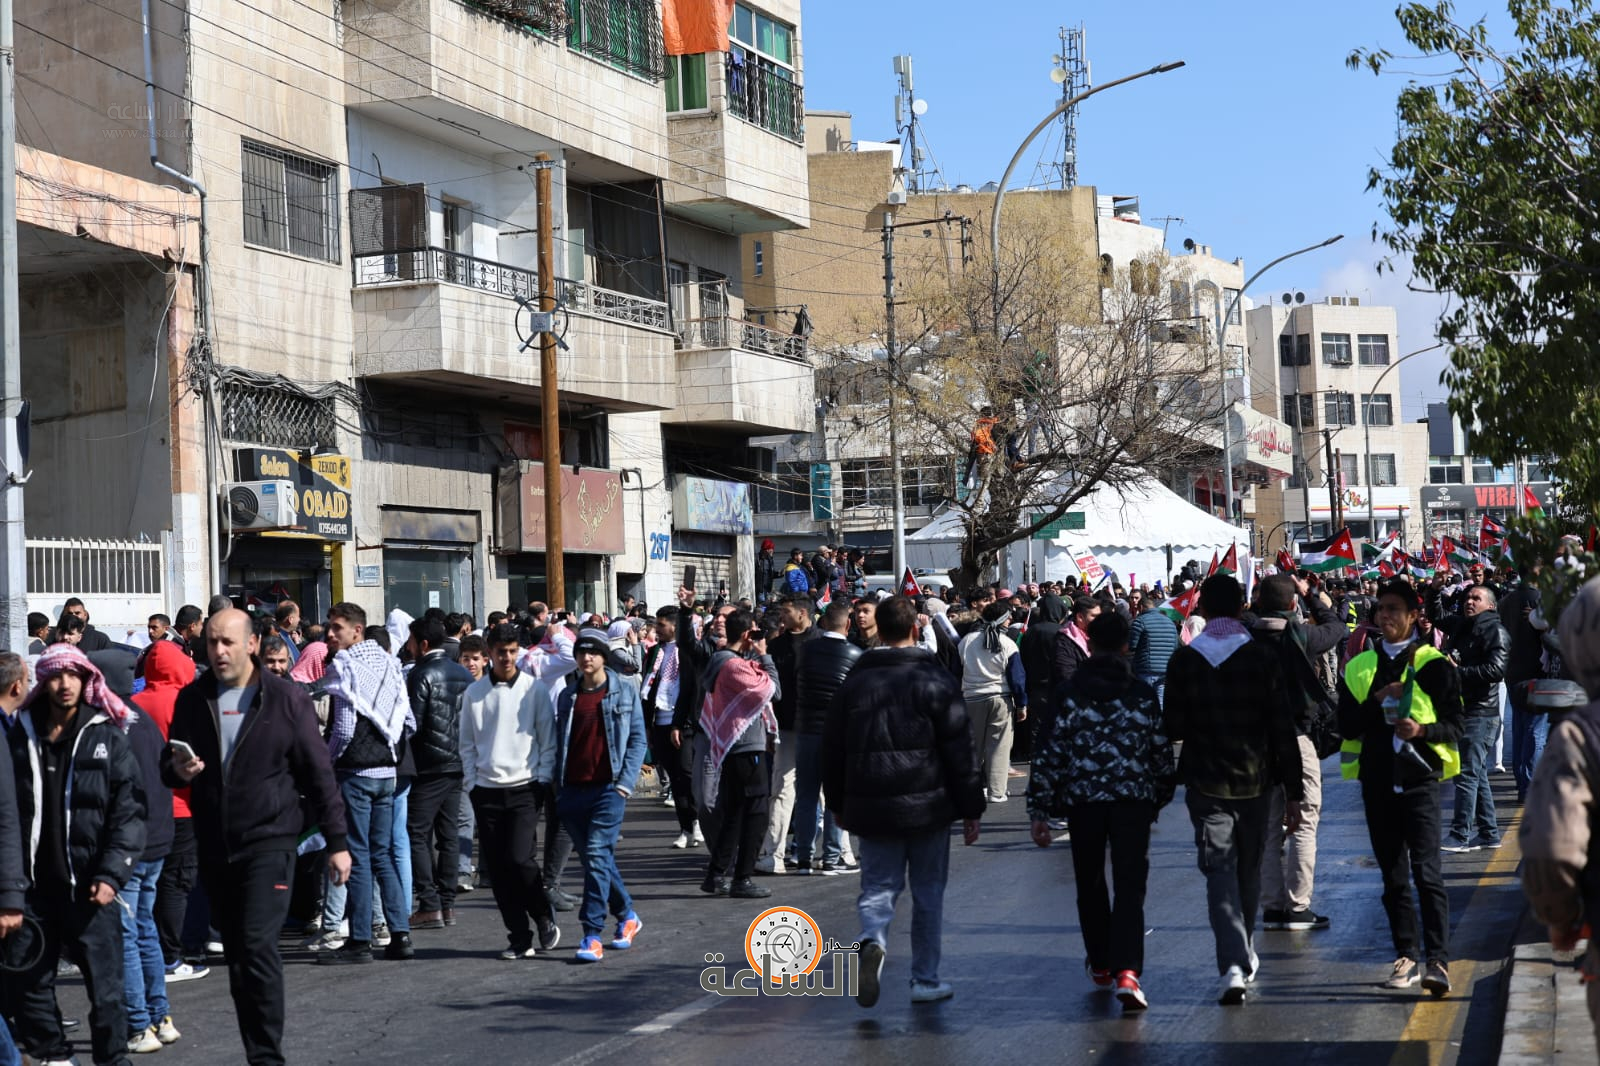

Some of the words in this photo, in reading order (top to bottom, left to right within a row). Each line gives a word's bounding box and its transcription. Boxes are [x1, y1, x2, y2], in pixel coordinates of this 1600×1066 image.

[260, 454, 290, 477] Salon
[303, 488, 348, 519] OBAID
[649, 531, 671, 562] 287
